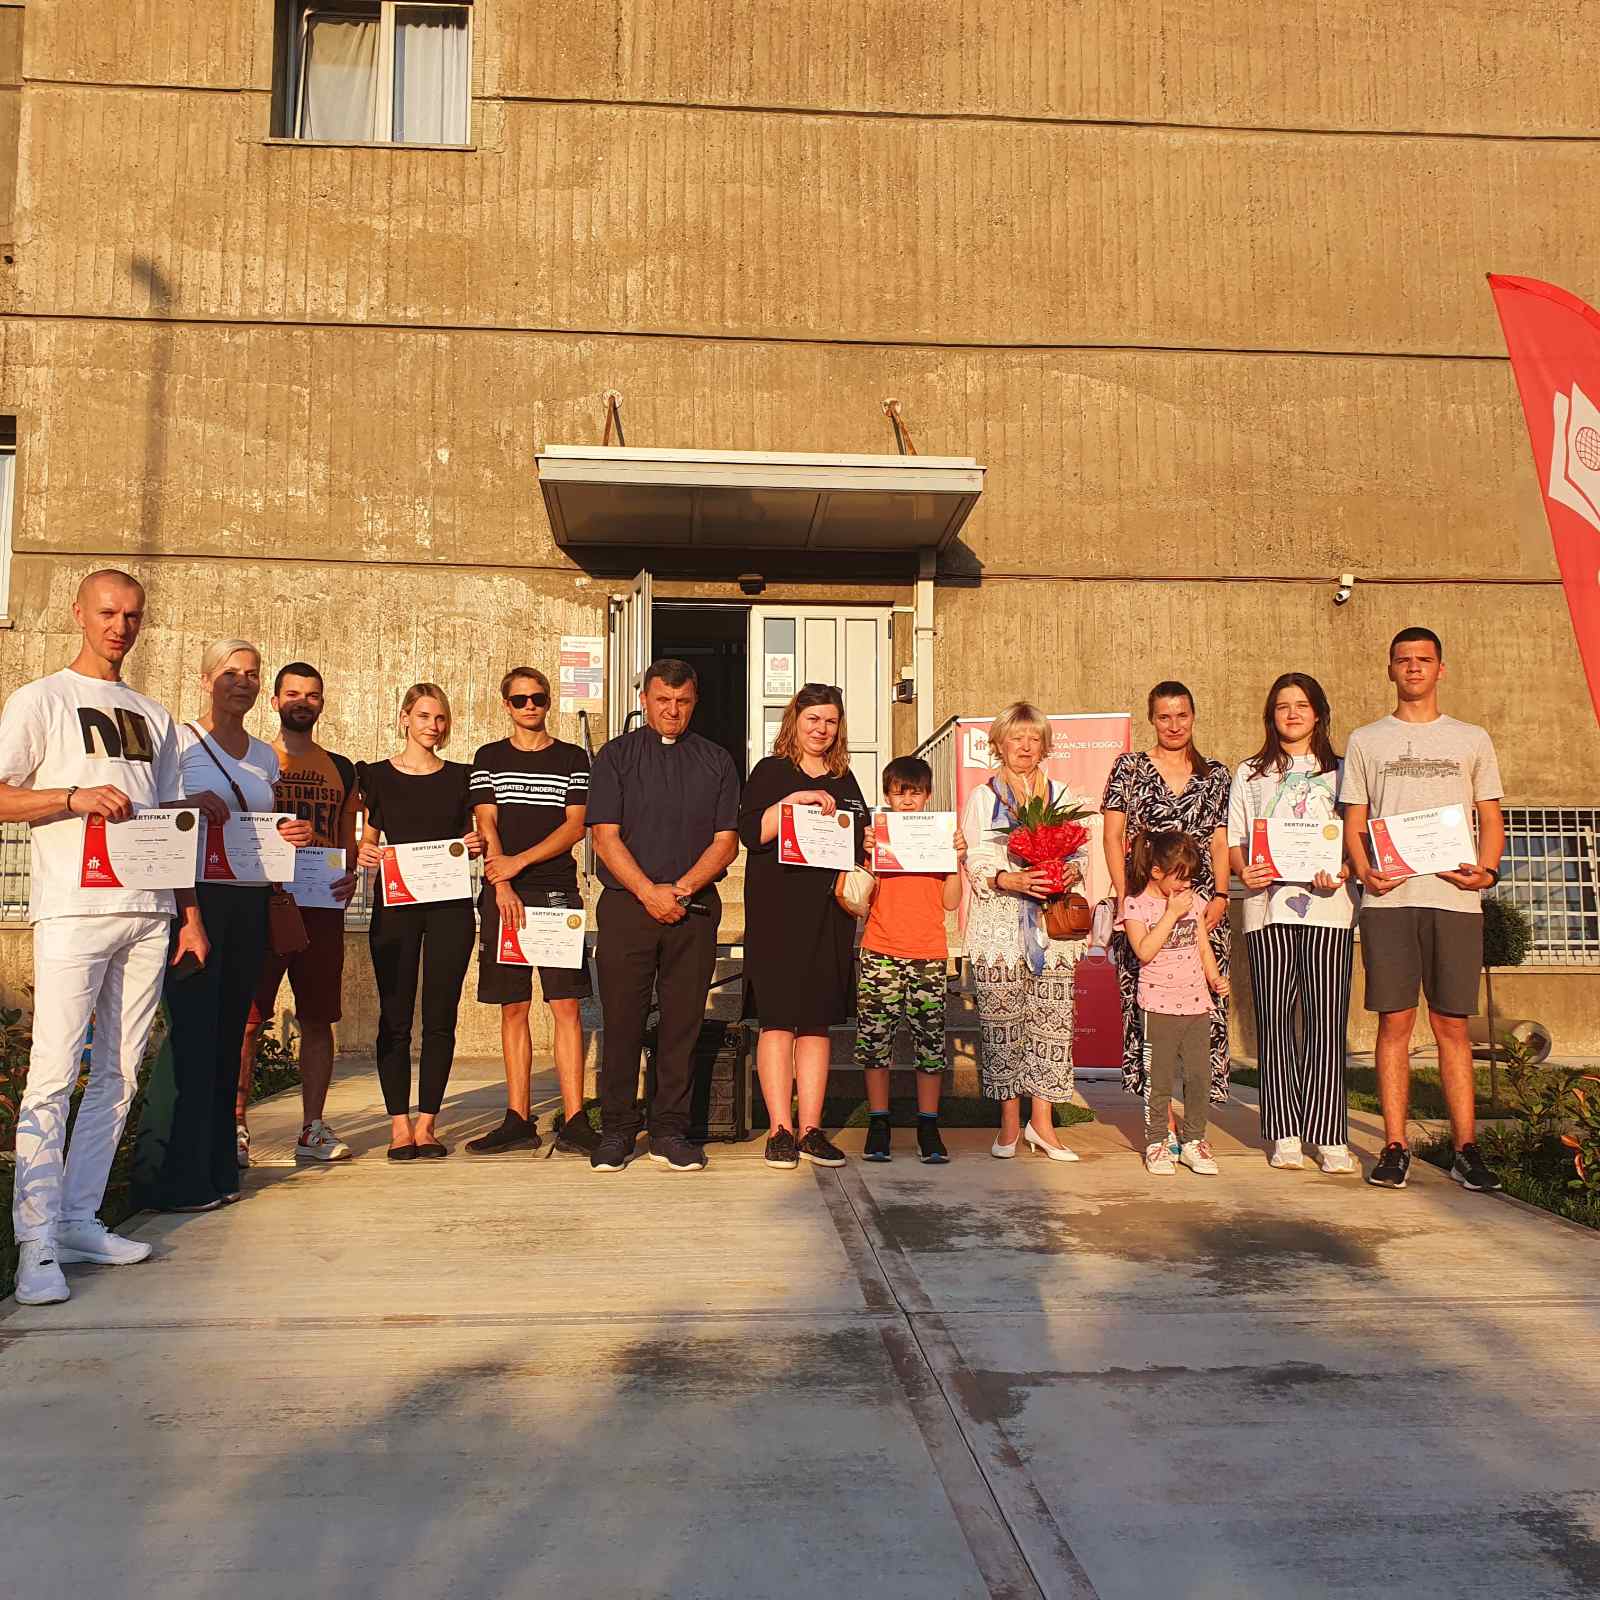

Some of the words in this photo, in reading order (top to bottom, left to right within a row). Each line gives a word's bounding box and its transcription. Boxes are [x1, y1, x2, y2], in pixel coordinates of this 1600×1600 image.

[280, 768, 328, 786] uality
[275, 785, 342, 802] STOMISED
[530, 785, 567, 796] UNDERRATE
[239, 815, 274, 823] SERTIFIKAT
